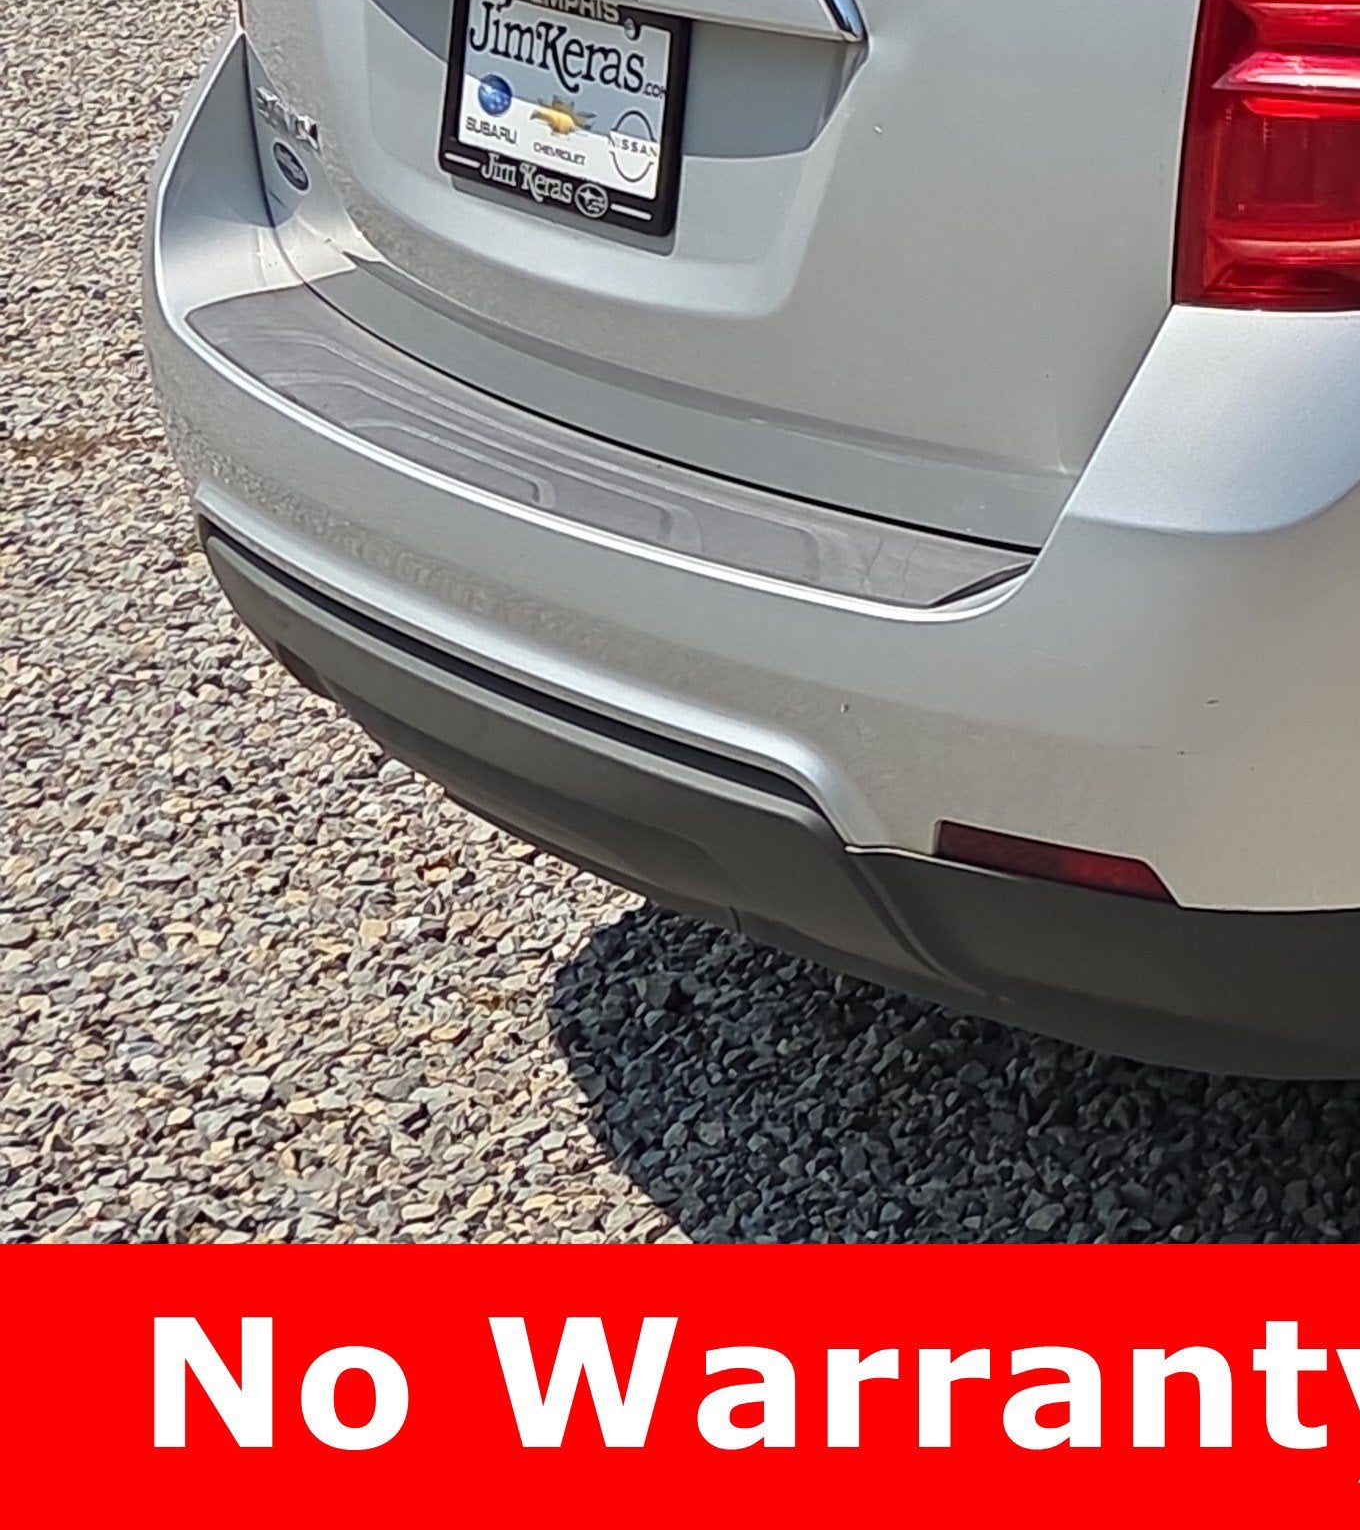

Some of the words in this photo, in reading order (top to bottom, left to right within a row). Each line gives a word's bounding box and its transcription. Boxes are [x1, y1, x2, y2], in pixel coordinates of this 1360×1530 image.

[465, 116, 517, 144] SUBARU
[533, 141, 586, 165] CHEVROLET
[607, 134, 658, 157] NISSAN
[481, 152, 517, 187] Jim
[519, 162, 573, 203] Keras
